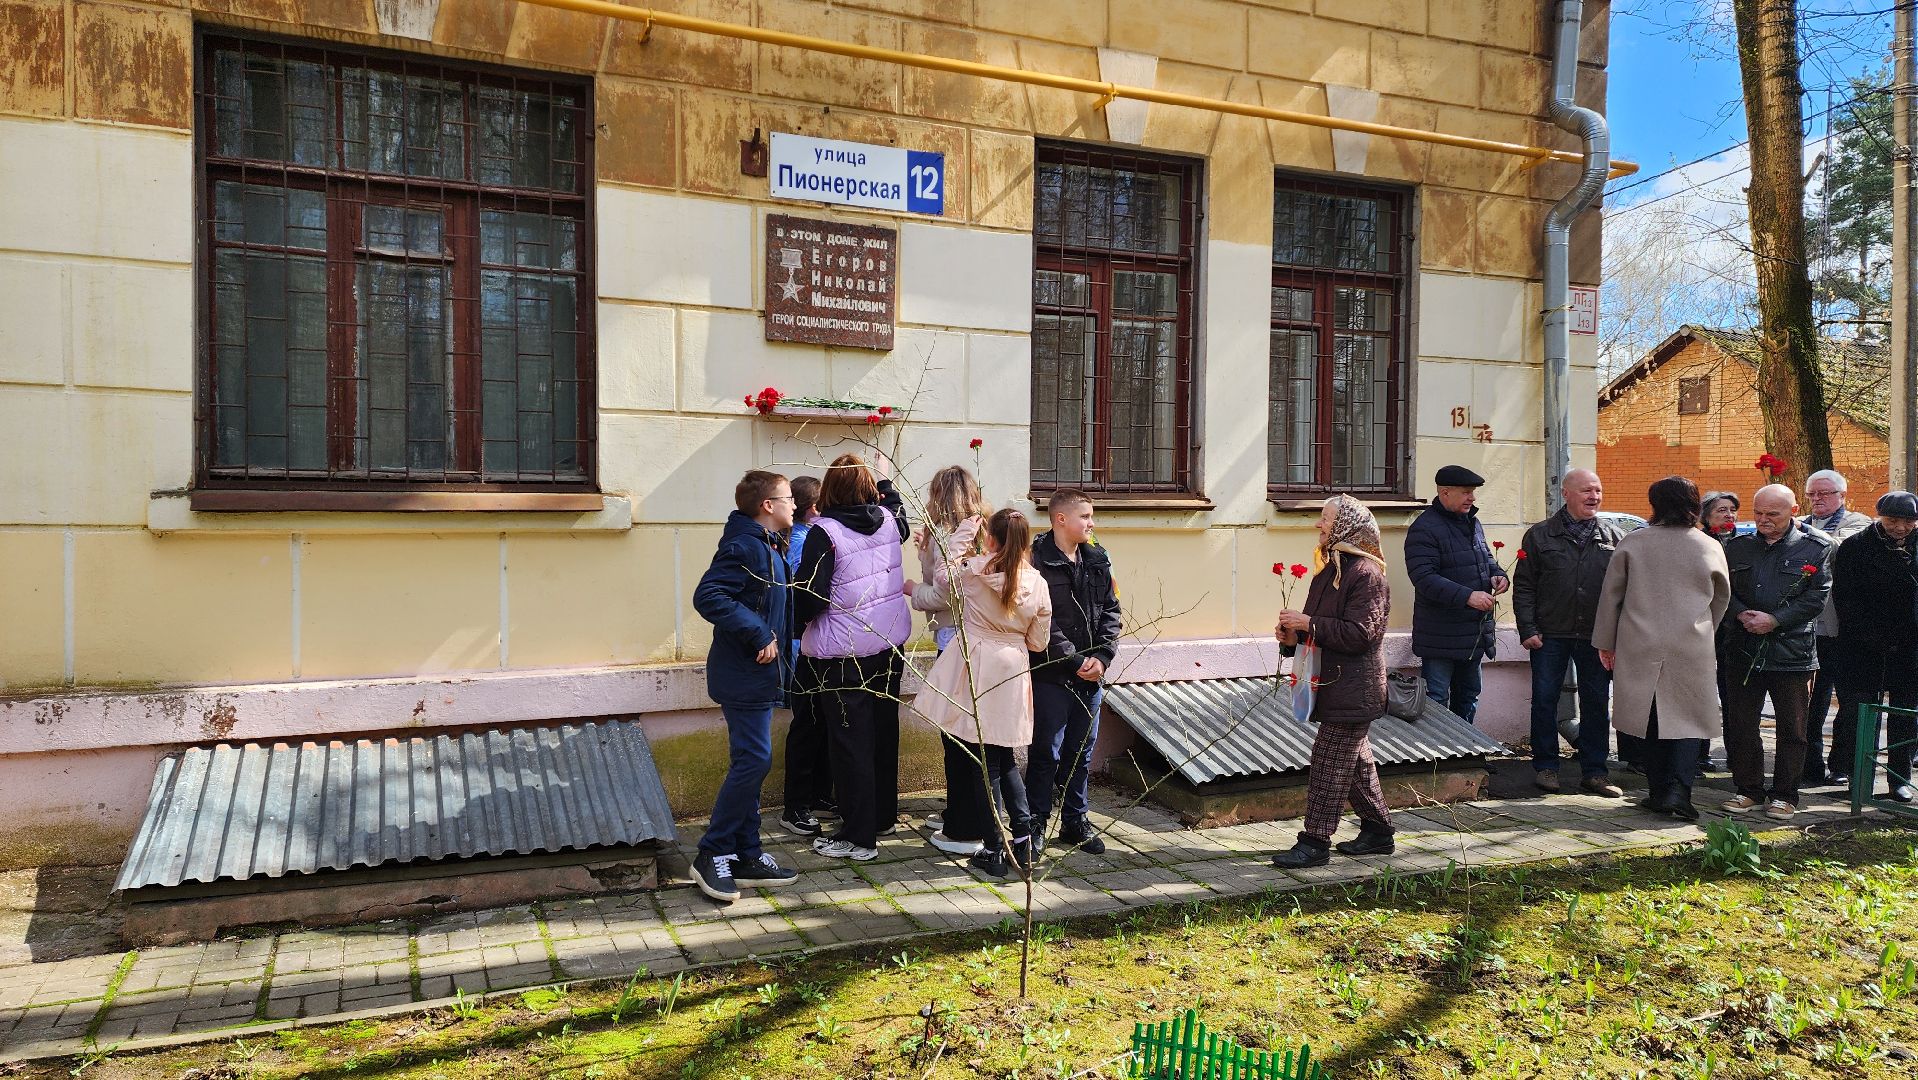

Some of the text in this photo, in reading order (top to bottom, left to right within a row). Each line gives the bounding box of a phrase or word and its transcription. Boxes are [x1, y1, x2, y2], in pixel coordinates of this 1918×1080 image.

[814, 147, 866, 166] улица
[778, 164, 939, 200] Пионерская 12
[776, 228, 888, 250] В ЭТОМ ДОМЕ ЖИЛ
[812, 249, 887, 271] Егоров
[811, 270, 886, 293] Николай
[811, 291, 886, 313] Михайлович
[771, 313, 892, 336] ГЕРОЙ СОЦИАЛИСТИЧЕСКОГО ТРУДА
